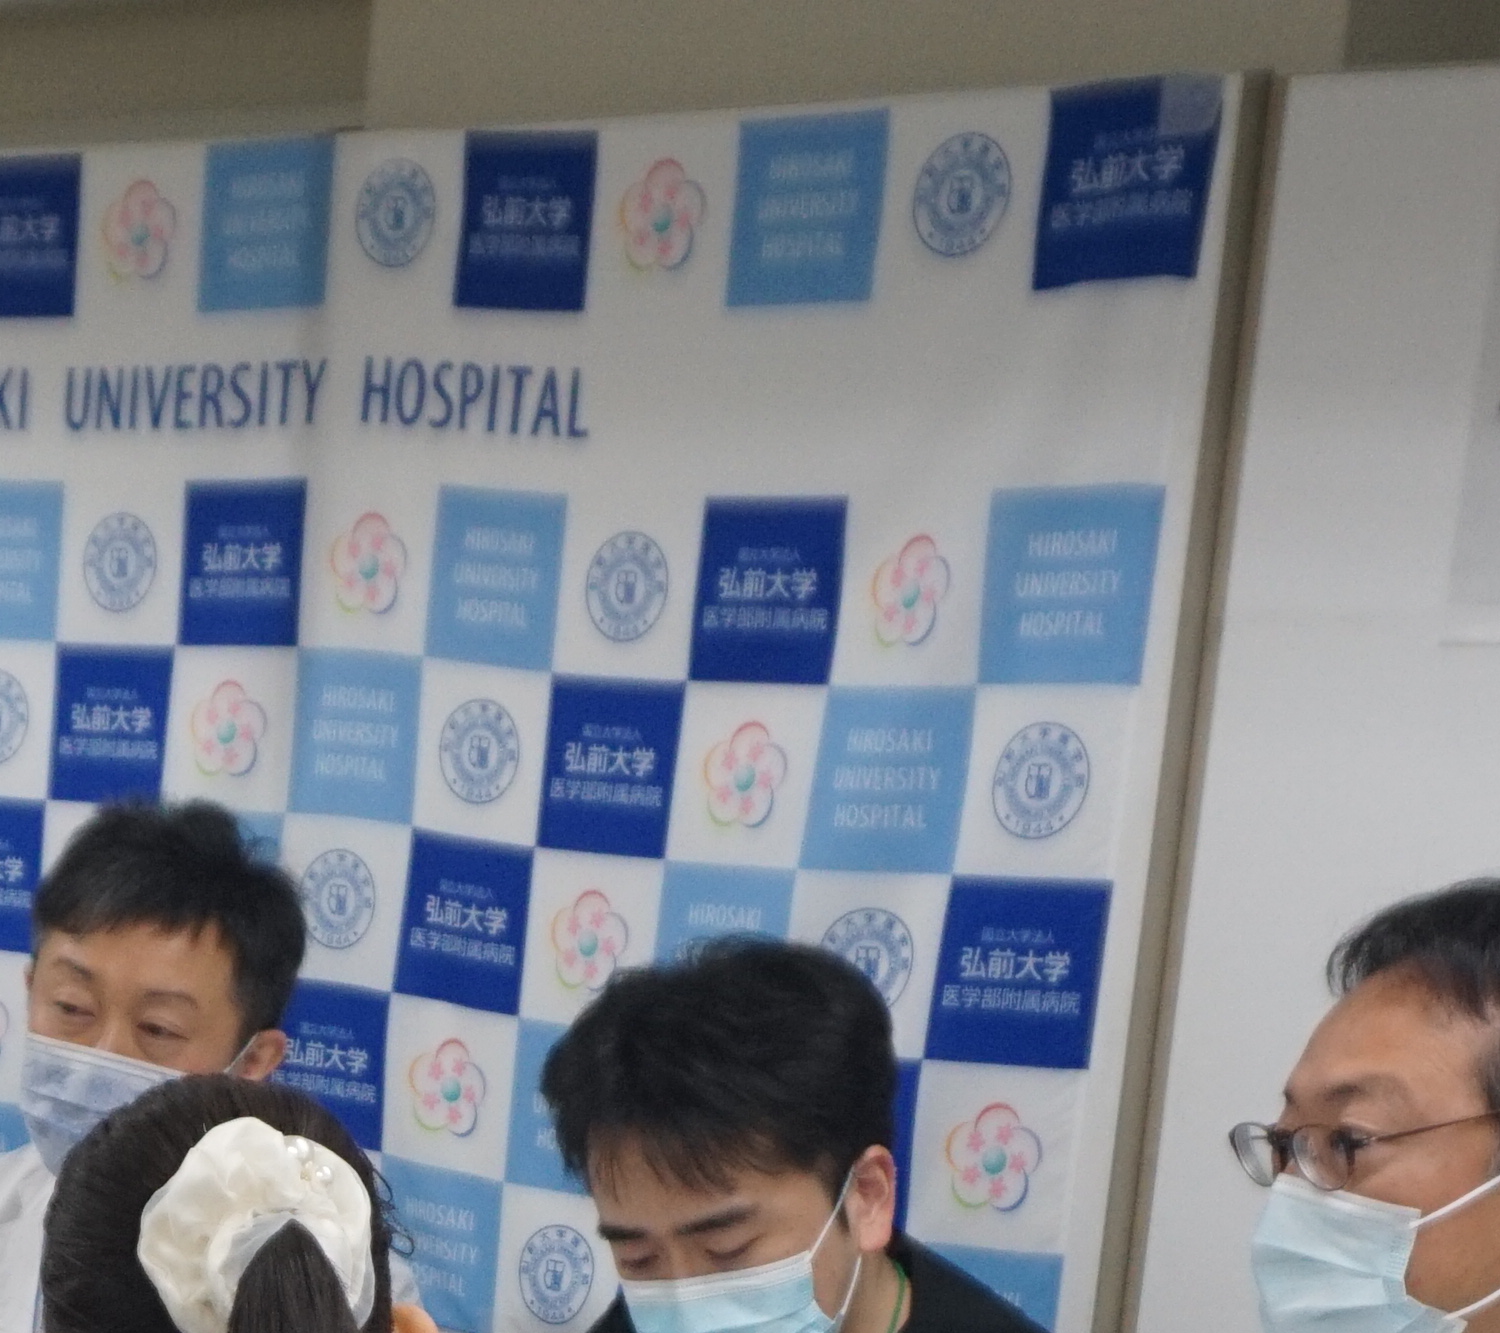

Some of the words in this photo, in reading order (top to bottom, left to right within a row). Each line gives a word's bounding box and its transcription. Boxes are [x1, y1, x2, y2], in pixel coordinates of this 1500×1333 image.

[1071, 145, 1184, 192] 弘前大学
[483, 193, 572, 228] 弘前大学
[64, 358, 328, 431] UNIVERSITY
[361, 358, 589, 438] HOSPITAL
[203, 544, 282, 571] 弘前大学
[1029, 529, 1117, 557] HIROSAKI
[718, 567, 818, 599] 弘前大学
[1015, 567, 1120, 597] UNIVERSITY
[1020, 612, 1103, 638] HOSPITAL
[71, 705, 152, 733] 弘前大学
[847, 728, 932, 754] HIROSAKI
[565, 742, 654, 776] 弘前大学
[834, 767, 939, 792] UNIVERSITY
[833, 802, 926, 829] HOSPITAL
[426, 894, 507, 935] 弘前大学
[688, 902, 761, 930] HIROSAKI
[960, 946, 1071, 983] 弘前大学
[942, 984, 1081, 1014] 医学部附属病院
[286, 1037, 368, 1074] 弘前大学
[405, 1195, 475, 1231] HIROSAKI
